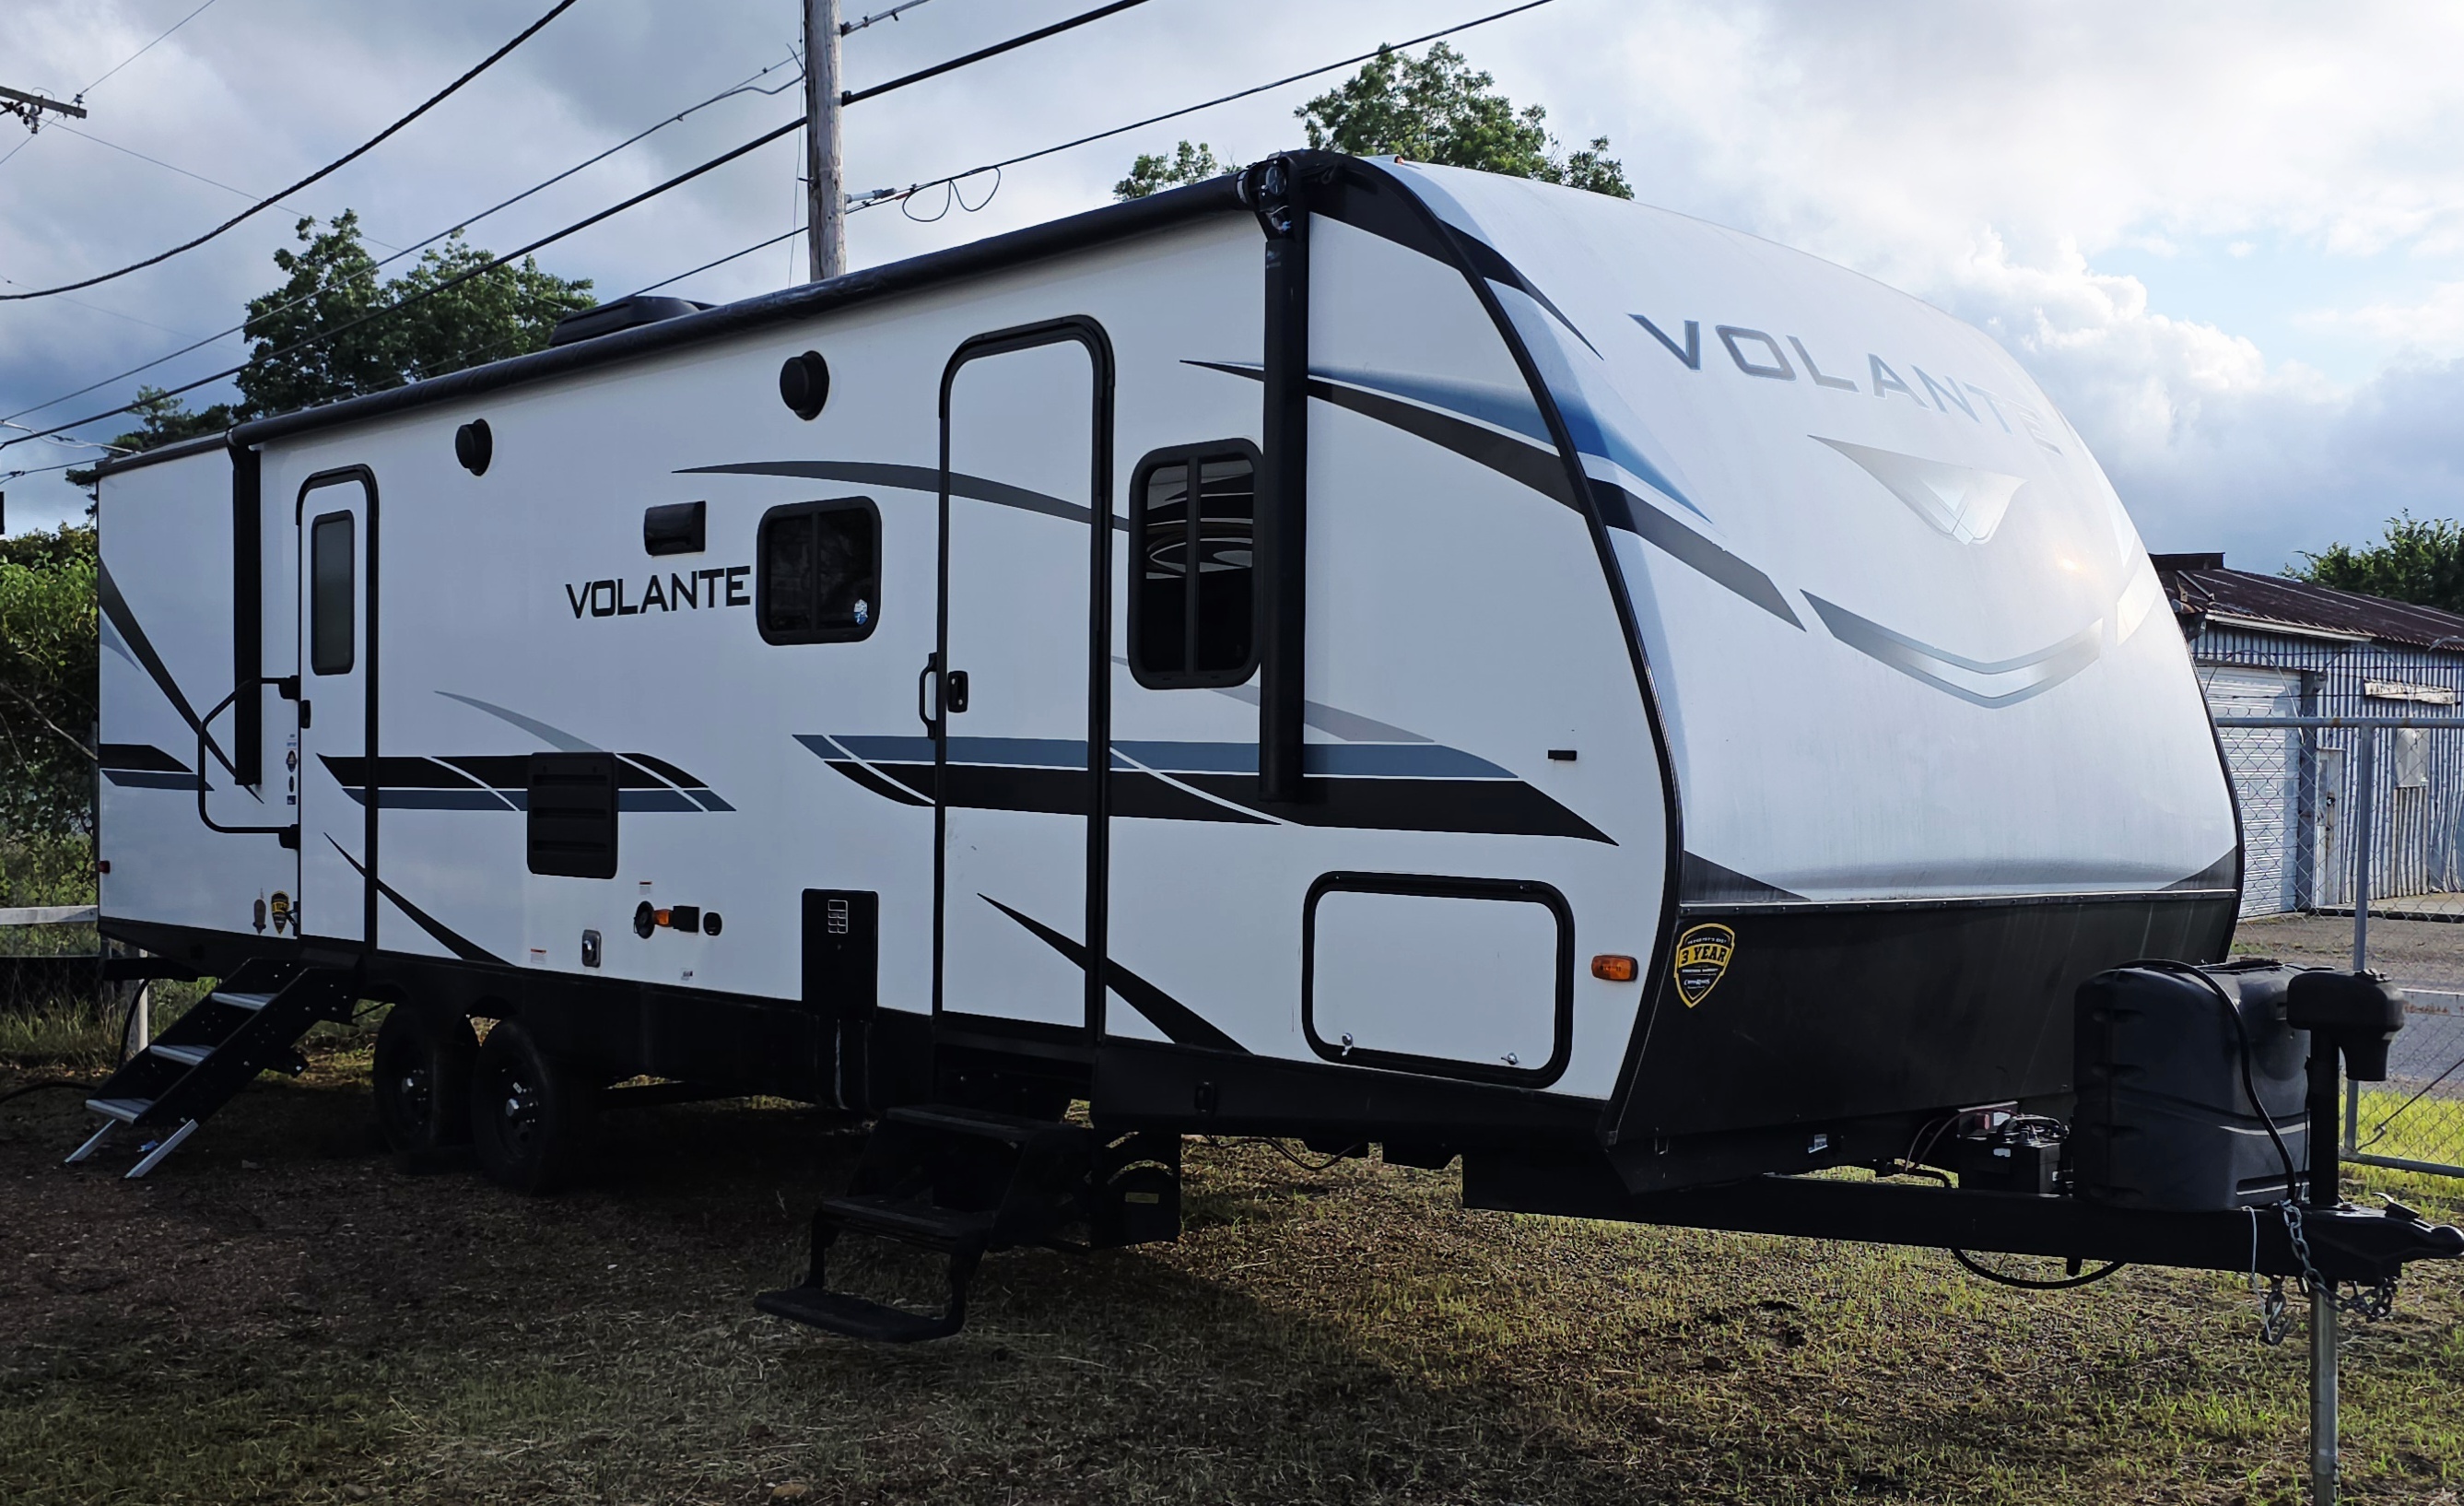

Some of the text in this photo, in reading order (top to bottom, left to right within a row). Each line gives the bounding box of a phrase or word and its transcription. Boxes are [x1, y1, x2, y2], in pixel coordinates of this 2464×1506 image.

[1625, 312, 2065, 457] VOLANTE
[565, 565, 751, 619] VOLANTE
[1681, 945, 1728, 965] 3 YEAR
